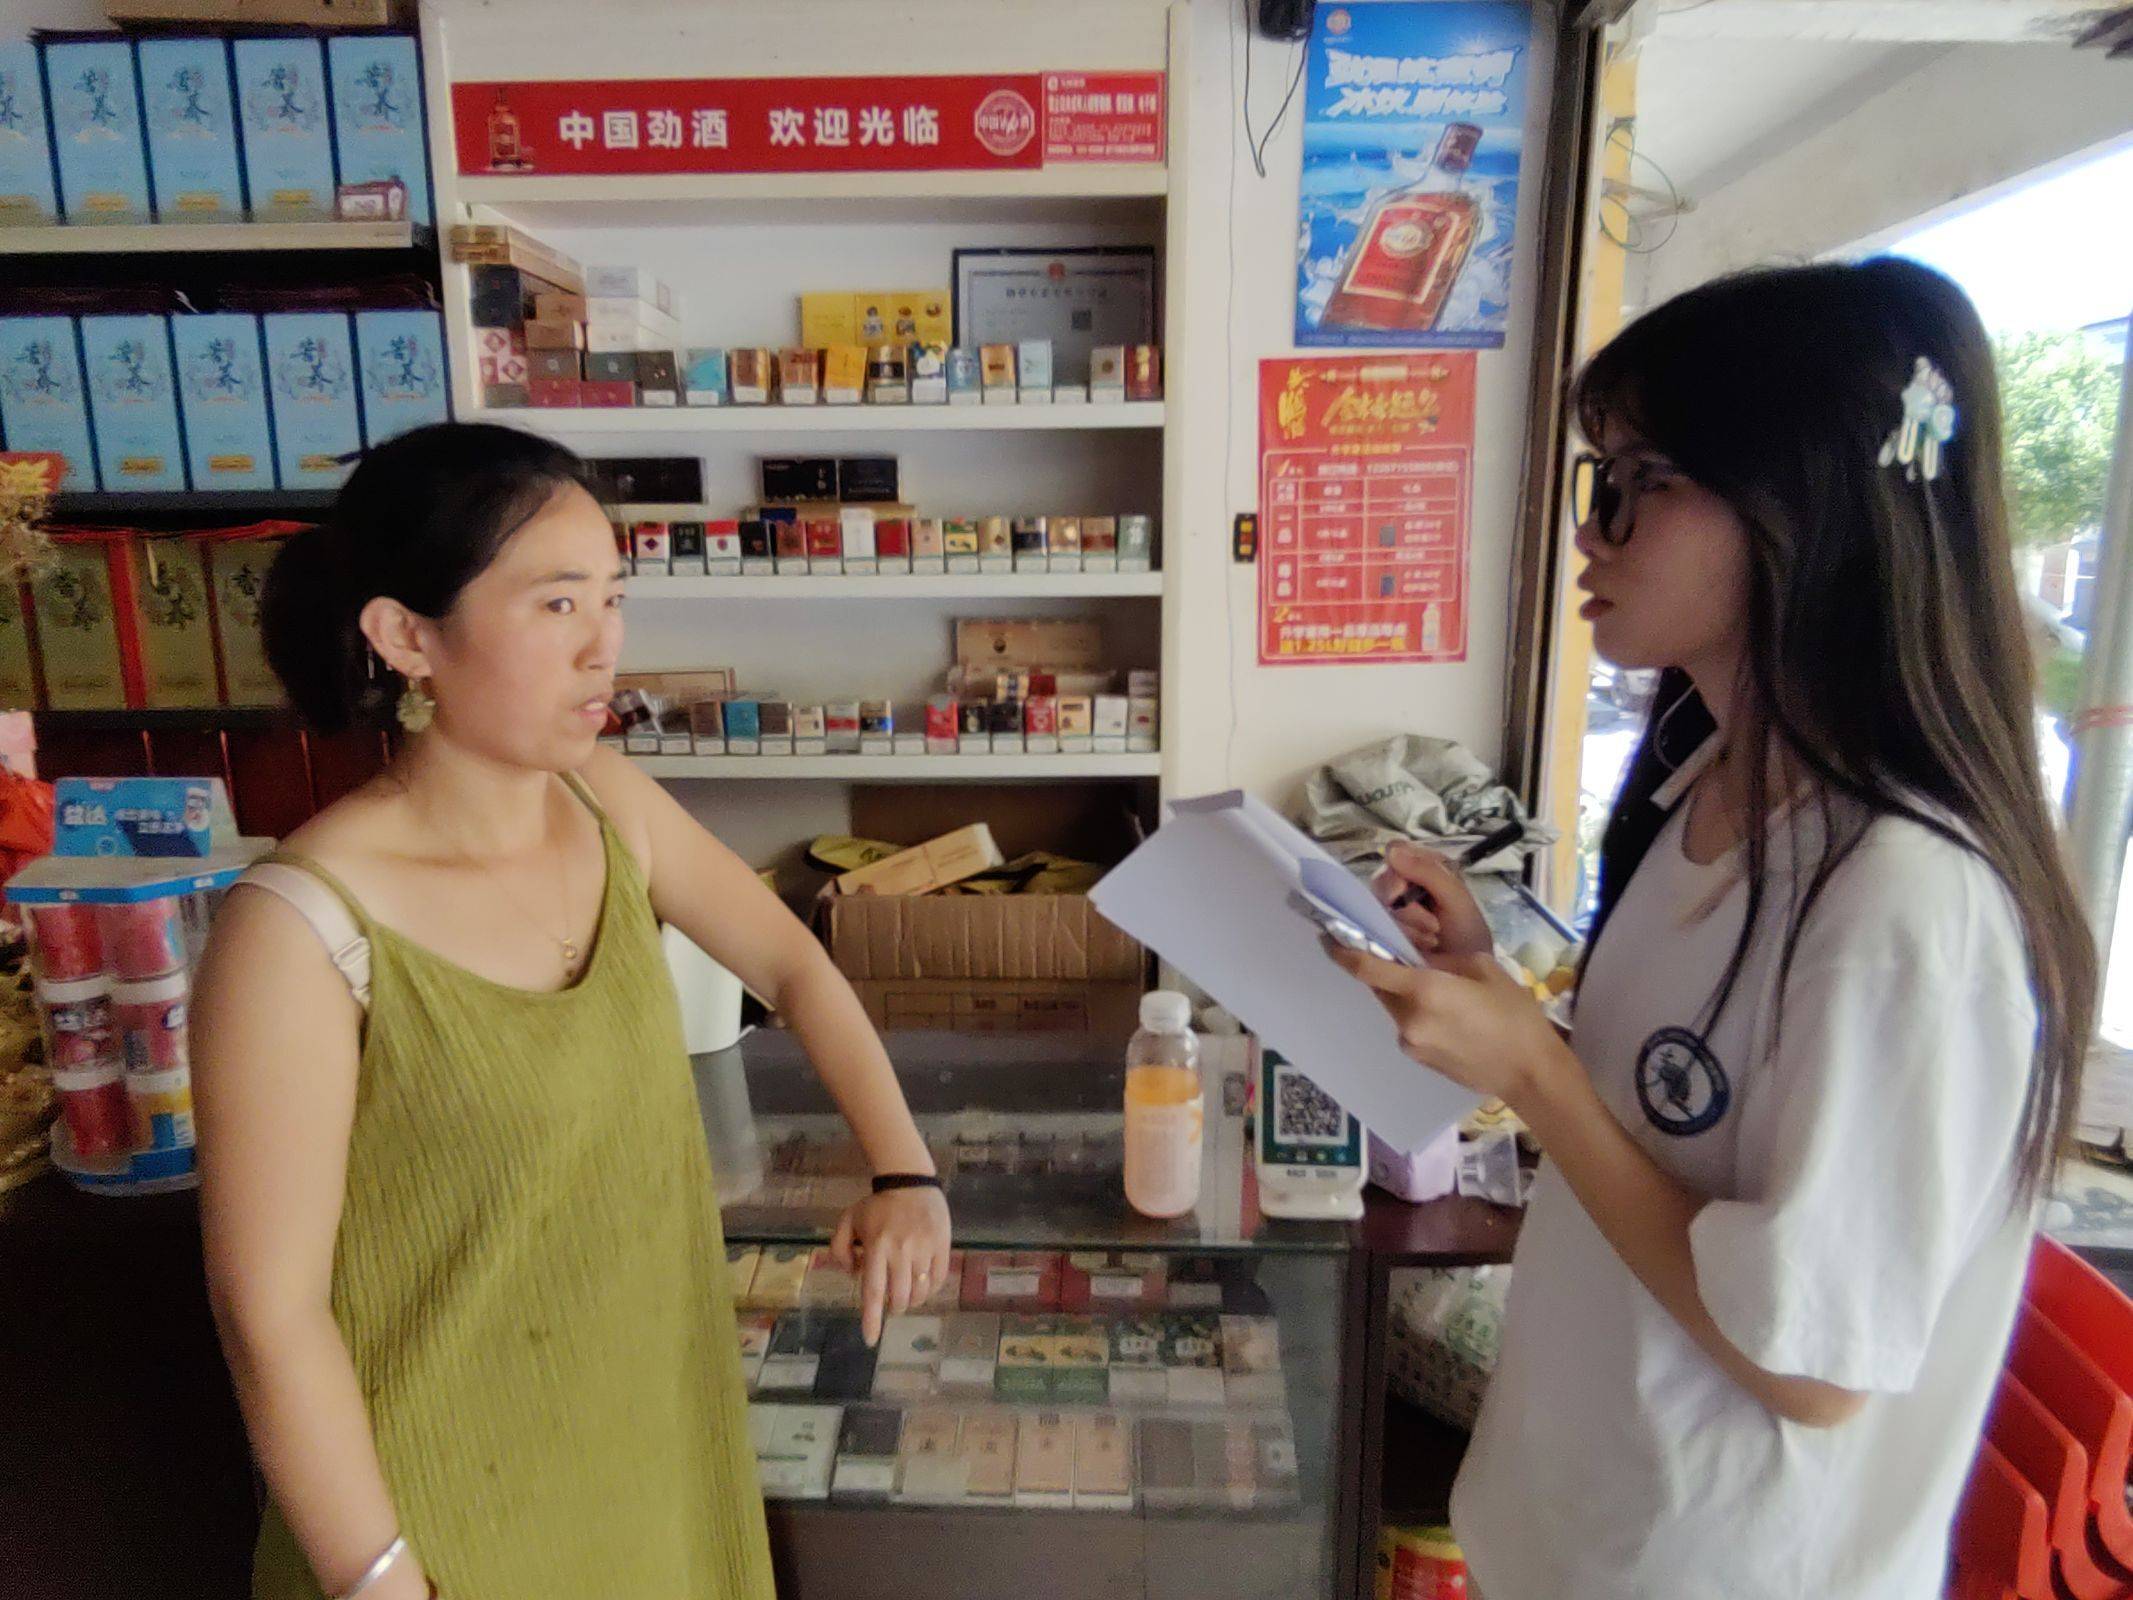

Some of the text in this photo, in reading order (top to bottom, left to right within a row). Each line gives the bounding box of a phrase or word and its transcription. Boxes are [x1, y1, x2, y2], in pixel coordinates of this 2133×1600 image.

[558, 106, 940, 149] 中国劲酒 欢迎光临
